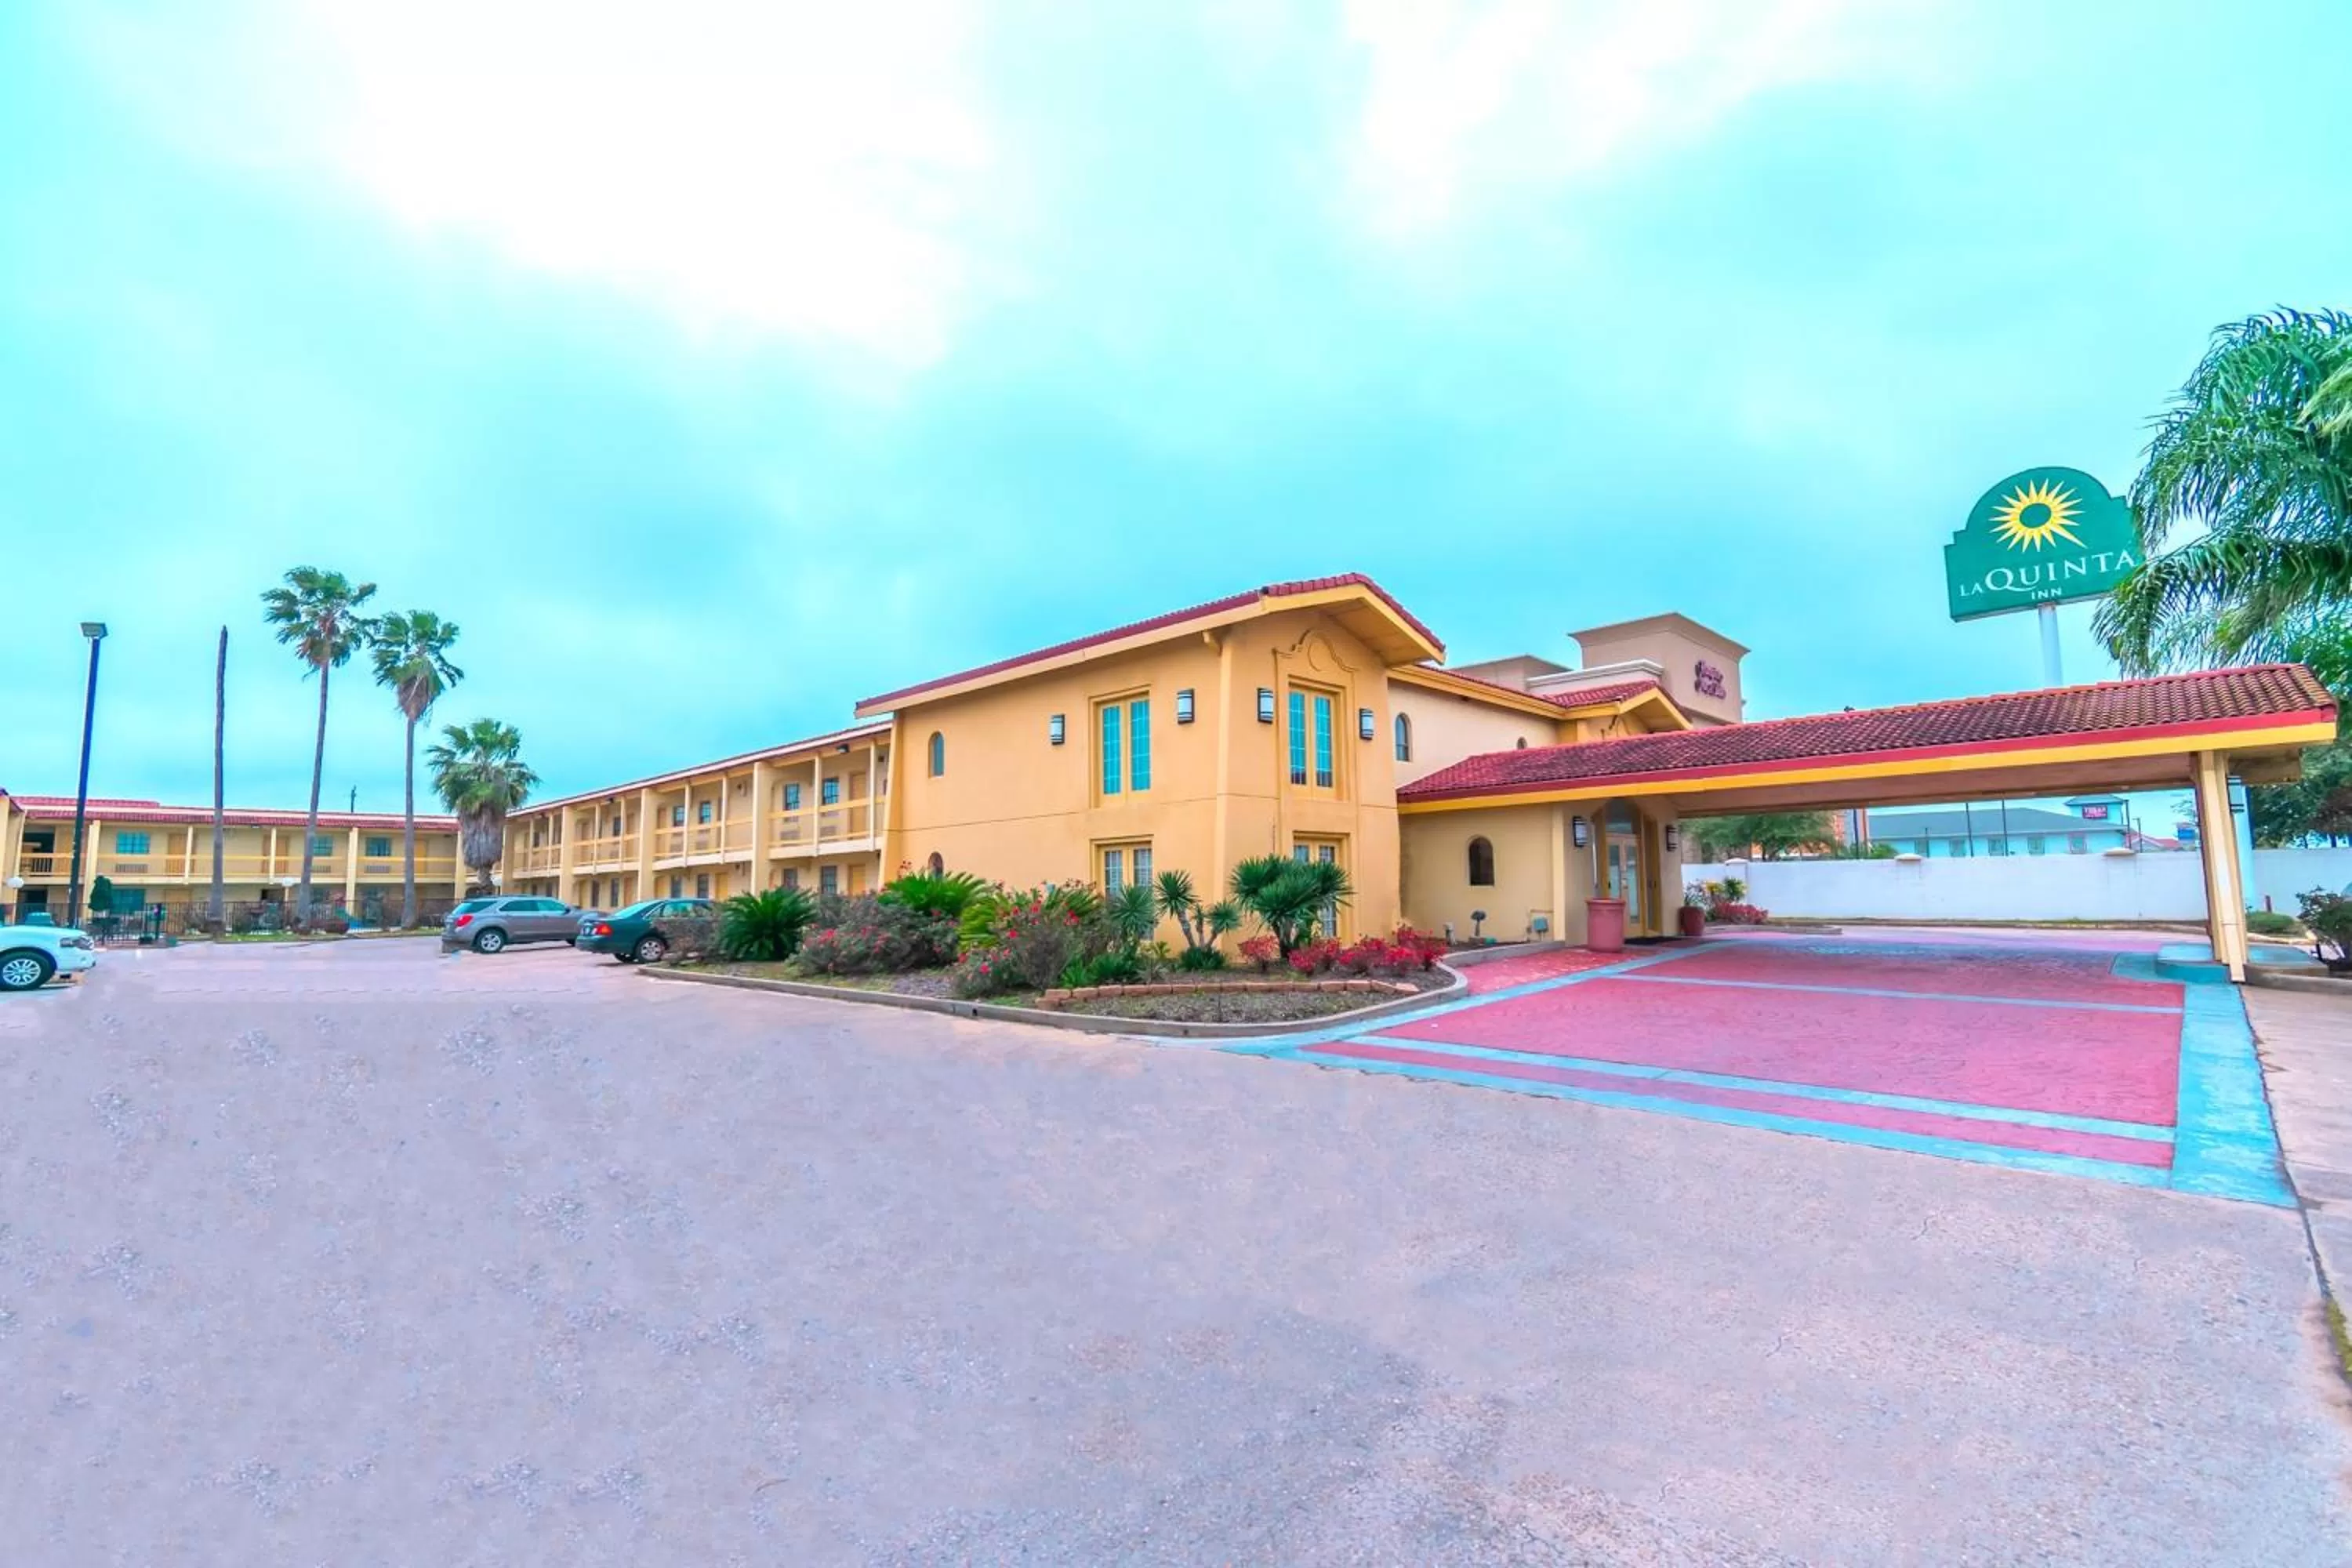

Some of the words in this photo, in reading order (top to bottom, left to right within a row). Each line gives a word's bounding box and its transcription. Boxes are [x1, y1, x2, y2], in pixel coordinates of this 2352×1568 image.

[1960, 583, 1983, 597] LA
[1984, 550, 2135, 592] QUINTA
[2032, 587, 2062, 600] INN
